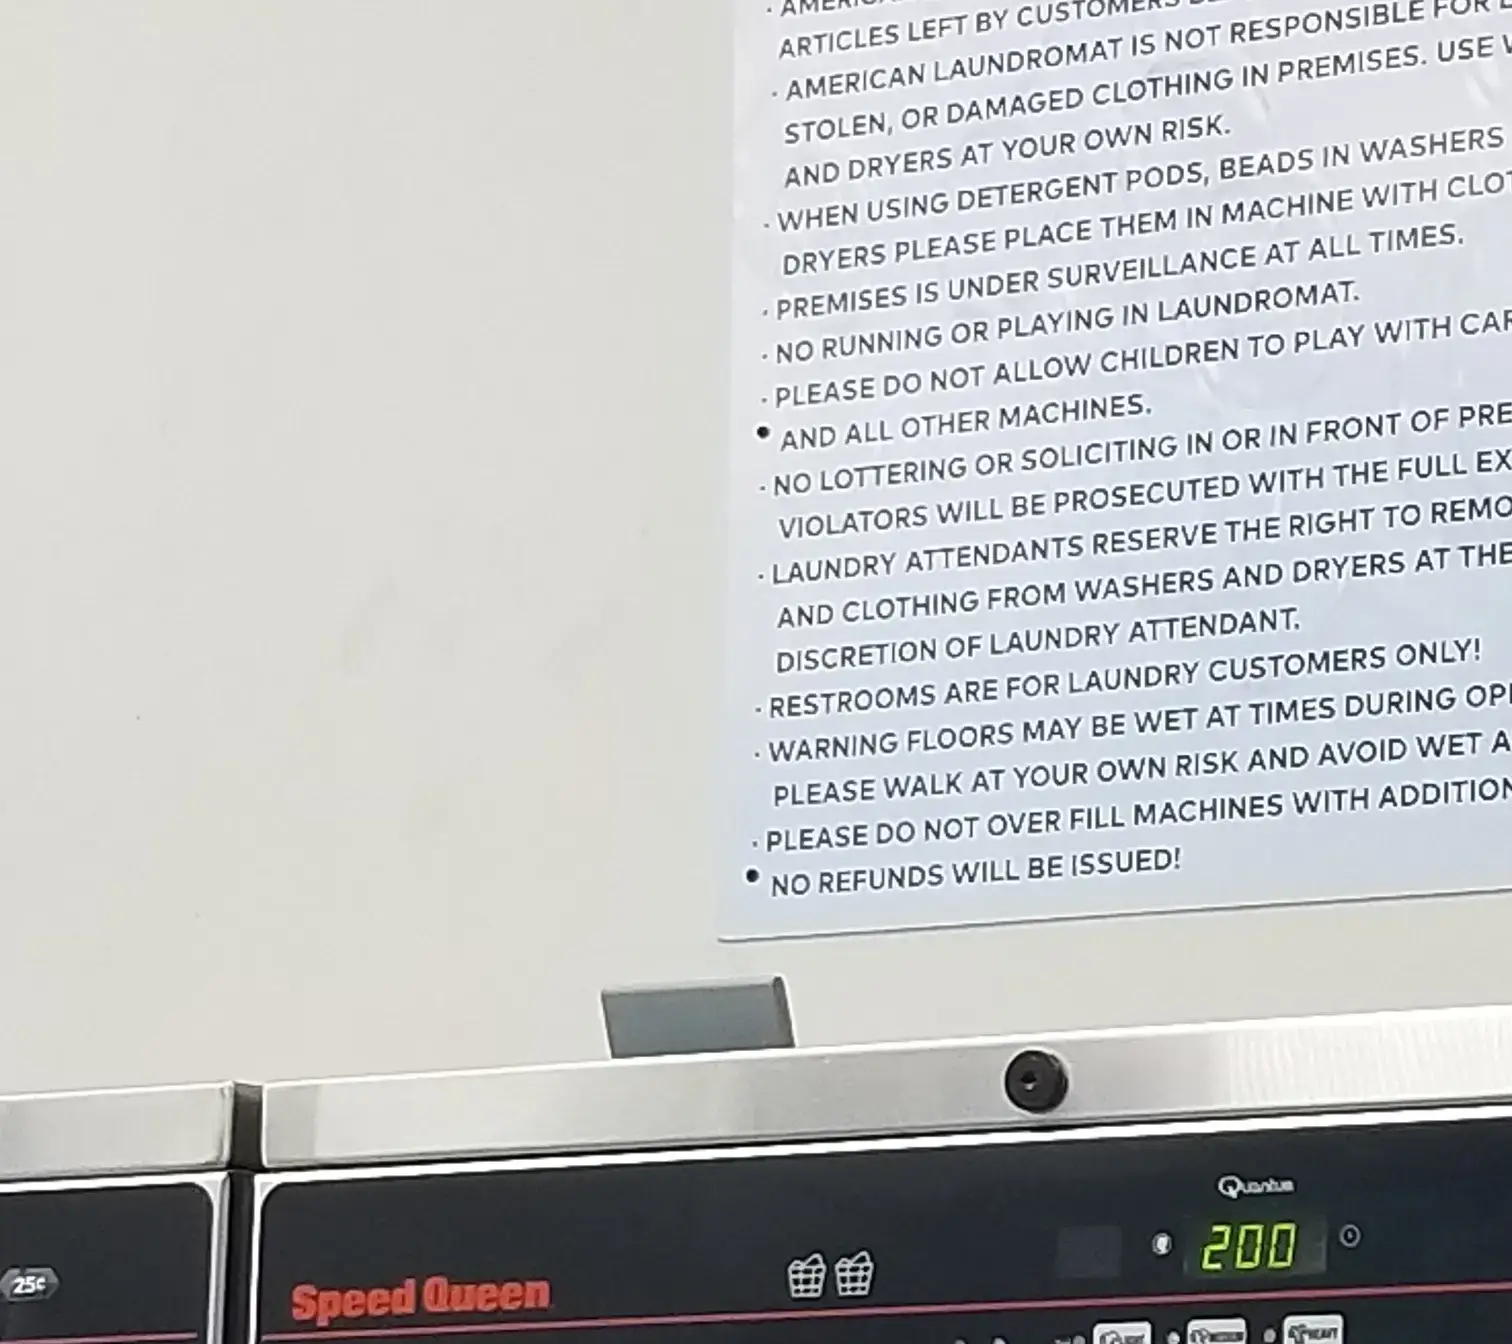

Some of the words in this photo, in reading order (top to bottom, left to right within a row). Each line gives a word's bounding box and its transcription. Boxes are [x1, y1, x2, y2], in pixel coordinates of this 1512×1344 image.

[777, 23, 900, 60] ARTICLES
[907, 13, 969, 43] LEFT
[975, 7, 1010, 34] BY
[783, 160, 841, 190] AND
[847, 146, 953, 182] DRYERS
[959, 141, 995, 168] AT
[1001, 131, 1077, 162] YOUR
[1083, 121, 1153, 152] OWN
[1161, 113, 1232, 143] RISK.
[776, 284, 908, 322] PREMISES
[915, 280, 940, 306] IS
[947, 269, 1040, 302] UNDER
[1046, 244, 1257, 290] SURVEILLANCE
[1262, 239, 1302, 267] AT
[1307, 233, 1362, 262] ALL
[1367, 222, 1464, 254] TIMES.
[775, 339, 815, 365] NO
[821, 324, 943, 360] RUNNING
[950, 320, 990, 345] OR
[997, 306, 1115, 341] PLAYING
[1121, 302, 1149, 327] IN
[1157, 279, 1361, 323] LAUNDROMAT.
[773, 471, 813, 497] NO
[974, 451, 1014, 477] OR
[1020, 434, 1179, 472] SOLICITING
[1186, 430, 1214, 457] IN
[1221, 426, 1262, 452] OR
[1269, 421, 1298, 448] IN
[1305, 411, 1403, 445] FRONT
[1409, 406, 1451, 434] OF
[776, 637, 937, 675] DISCRETION
[944, 634, 984, 660] OF
[989, 621, 1122, 657] LAUNDRY
[1127, 606, 1301, 644] ATTENDANT.
[769, 683, 937, 720] RESTROOMS
[942, 677, 999, 706] ARE
[1005, 673, 1060, 701] FOR
[1067, 660, 1200, 695] LAUNDRY
[1207, 644, 1387, 683] CUSTOMERS
[1395, 636, 1481, 667] ONLY!
[770, 872, 812, 898] NO
[817, 862, 945, 895] REFUNDS
[950, 858, 1021, 886] WILL
[1026, 854, 1065, 880] BE
[1071, 846, 1181, 878] ISSUED!
[1201, 1221, 1298, 1270] 200
[291, 1279, 417, 1327] Speed
[422, 1275, 551, 1314] Queen
